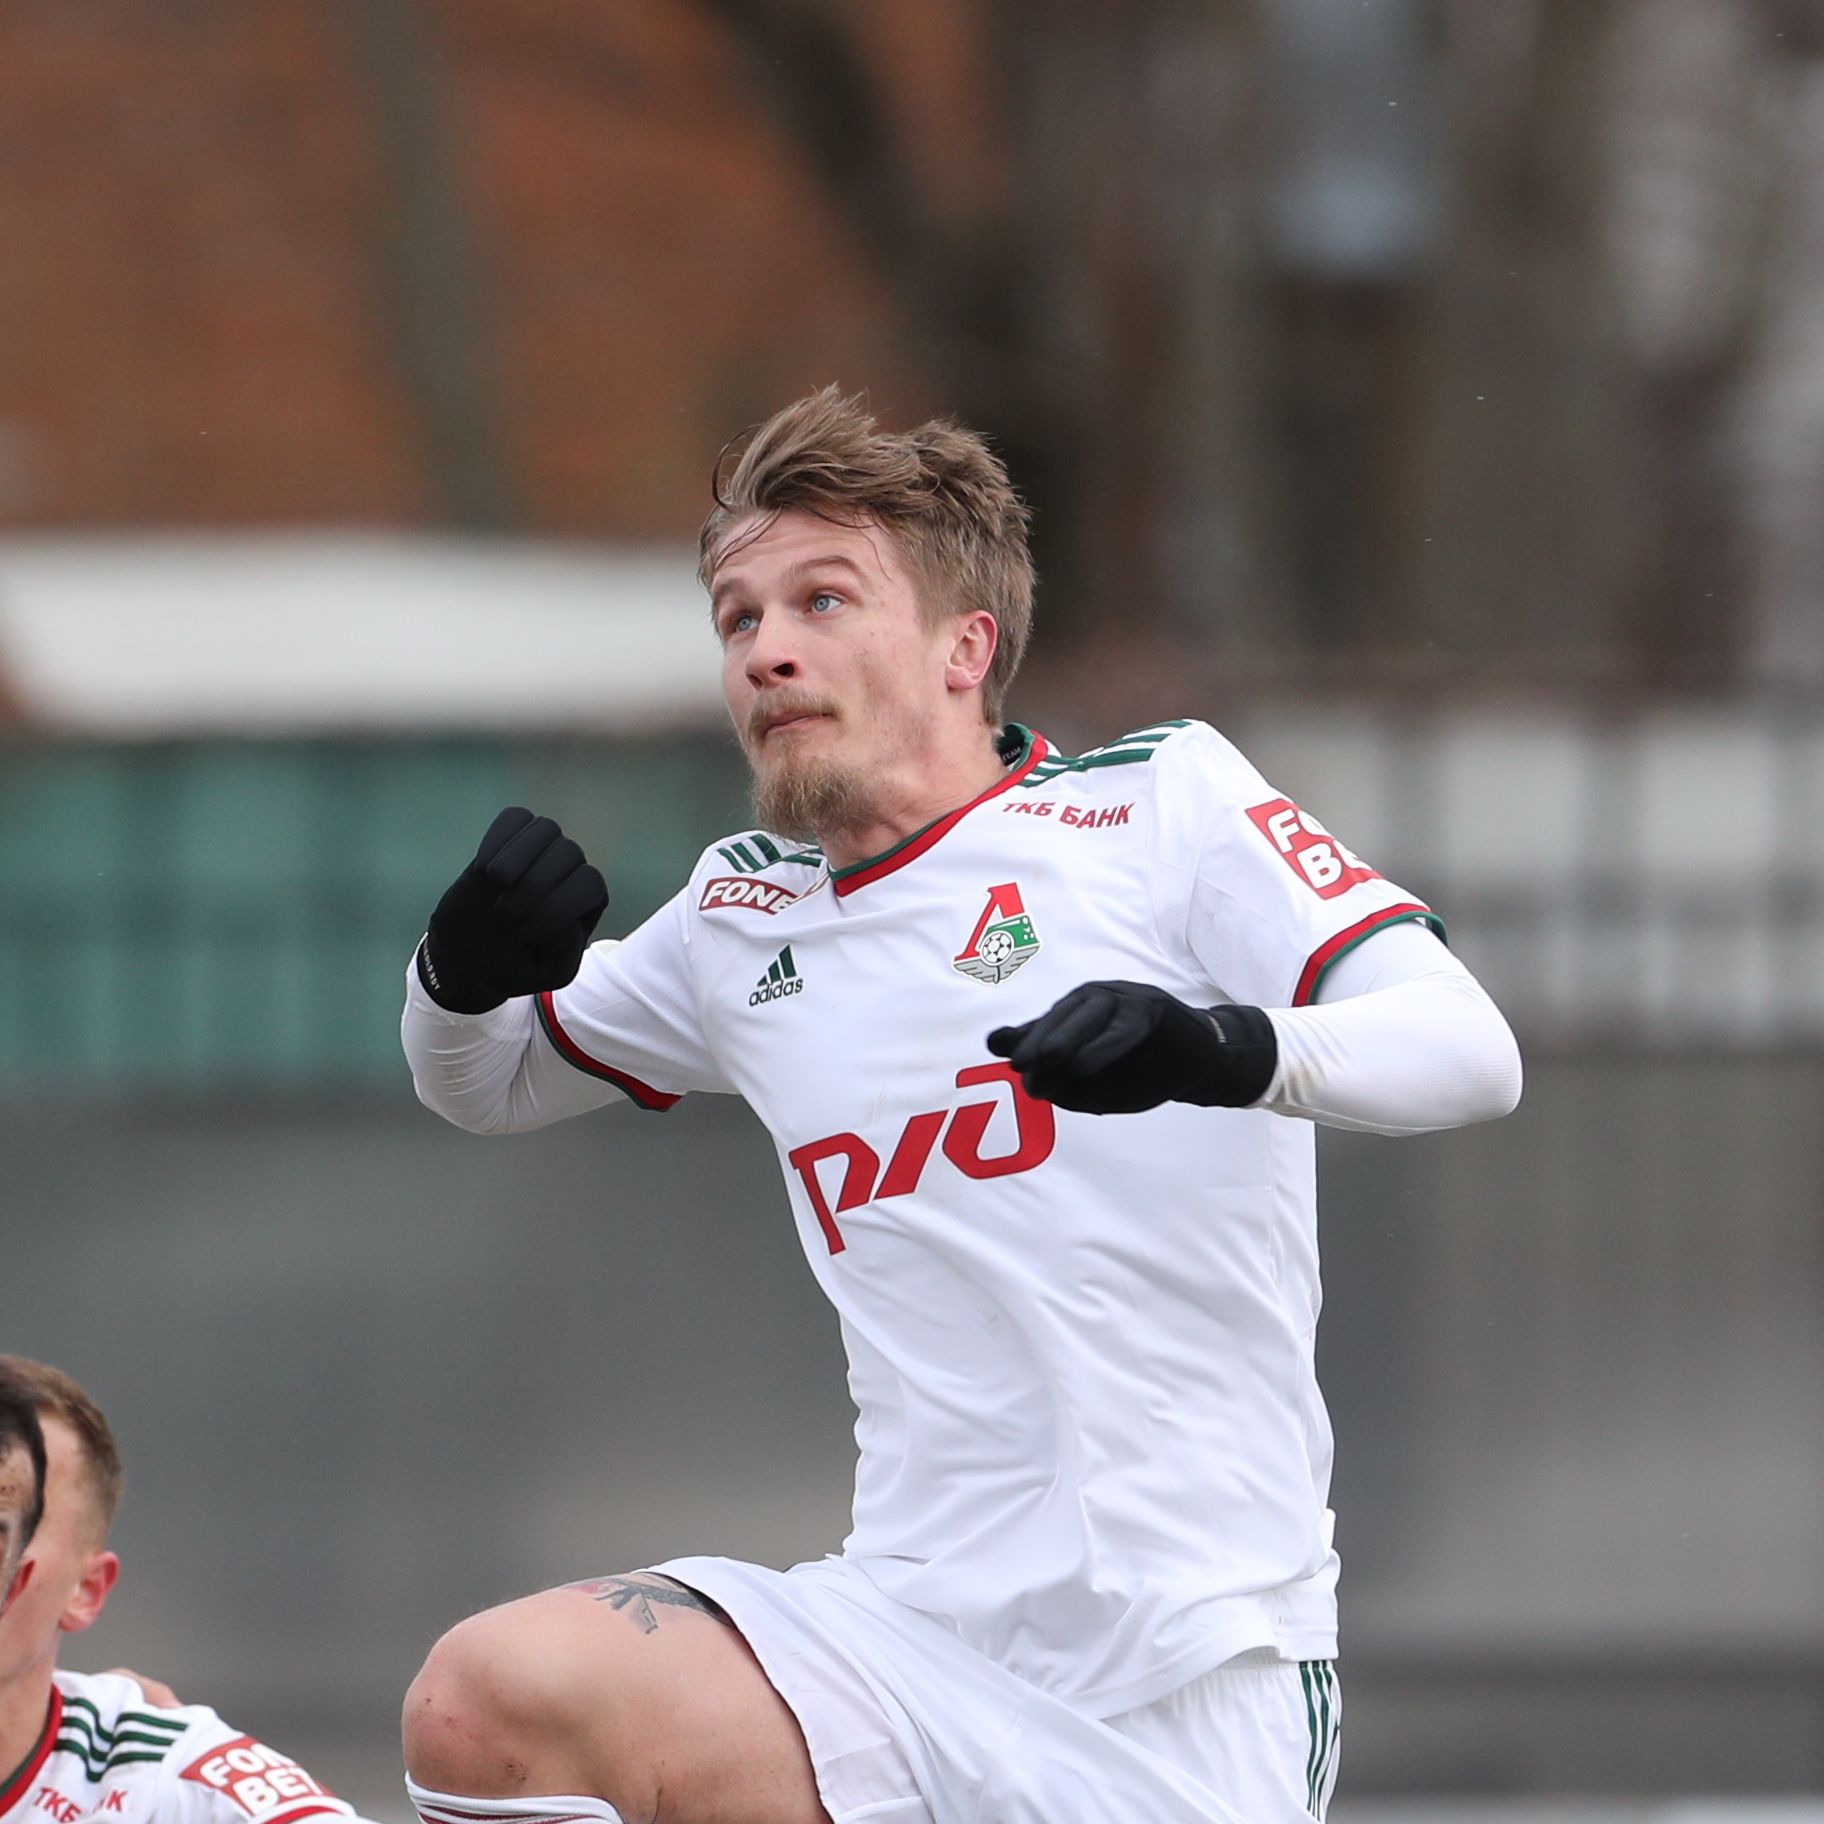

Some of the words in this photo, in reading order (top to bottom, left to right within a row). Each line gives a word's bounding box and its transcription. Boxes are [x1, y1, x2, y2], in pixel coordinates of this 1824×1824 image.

[1002, 801, 1057, 817] ТКБ
[1059, 803, 1136, 829] БАНК
[748, 977, 804, 1007] adidas
[33, 1787, 82, 1824] ТКБ
